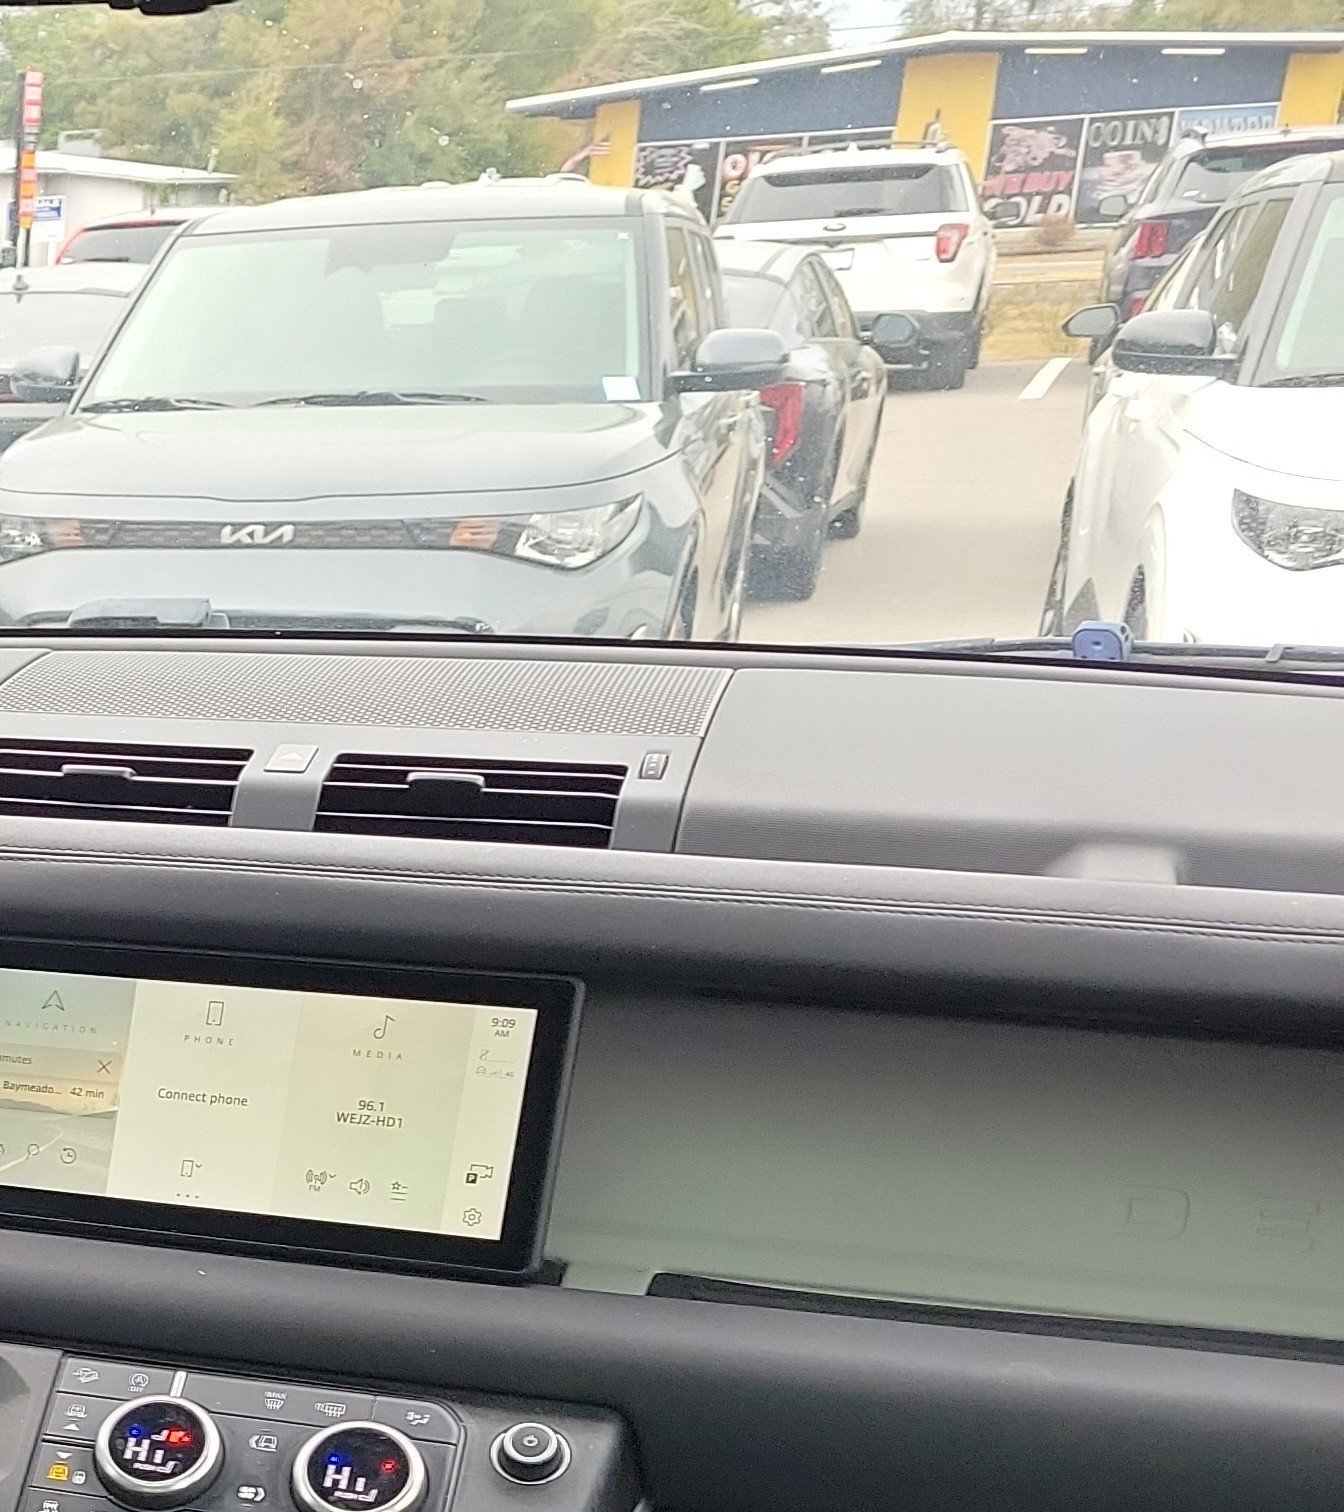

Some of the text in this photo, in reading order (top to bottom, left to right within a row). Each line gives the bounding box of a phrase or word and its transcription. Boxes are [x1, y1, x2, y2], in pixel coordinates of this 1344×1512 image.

[219, 523, 296, 545] KIA
[4, 1019, 99, 1035] NAVIGATION
[491, 1017, 516, 1029] 9:09
[183, 1034, 235, 1046] PHONE
[494, 1029, 510, 1038] AM
[352, 1049, 403, 1061] MEDIA
[69, 1086, 84, 1097] 42
[85, 1089, 105, 1099] min
[157, 1087, 249, 1107] Connect phone
[358, 1099, 385, 1112] 96.1
[336, 1111, 404, 1128] WEJZ-HD1
